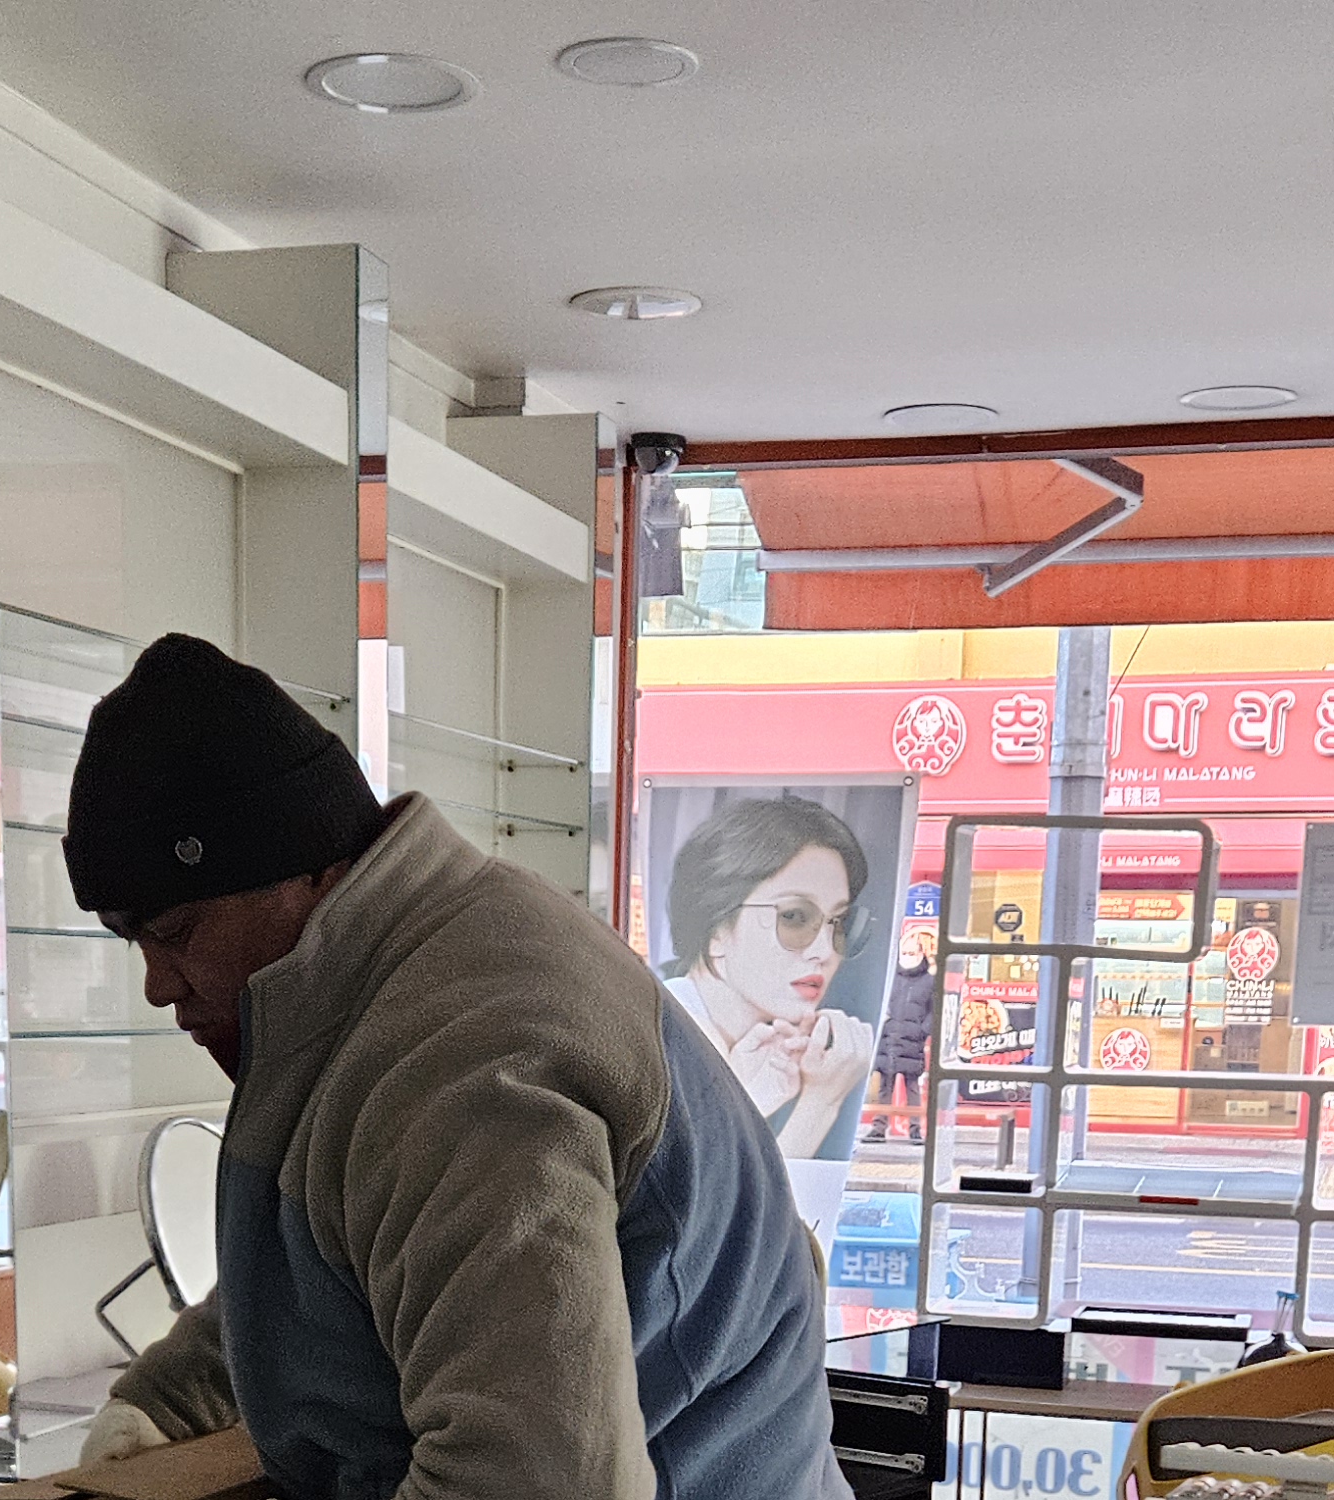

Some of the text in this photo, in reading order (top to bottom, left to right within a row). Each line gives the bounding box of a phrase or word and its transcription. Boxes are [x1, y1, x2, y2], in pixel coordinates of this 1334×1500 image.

[1163, 766, 1256, 781] MALATANG
[1116, 855, 1181, 867] MALATANG
[914, 901, 934, 915] 54
[1008, 986, 1037, 997] MALA
[840, 1247, 910, 1285] 보관함
